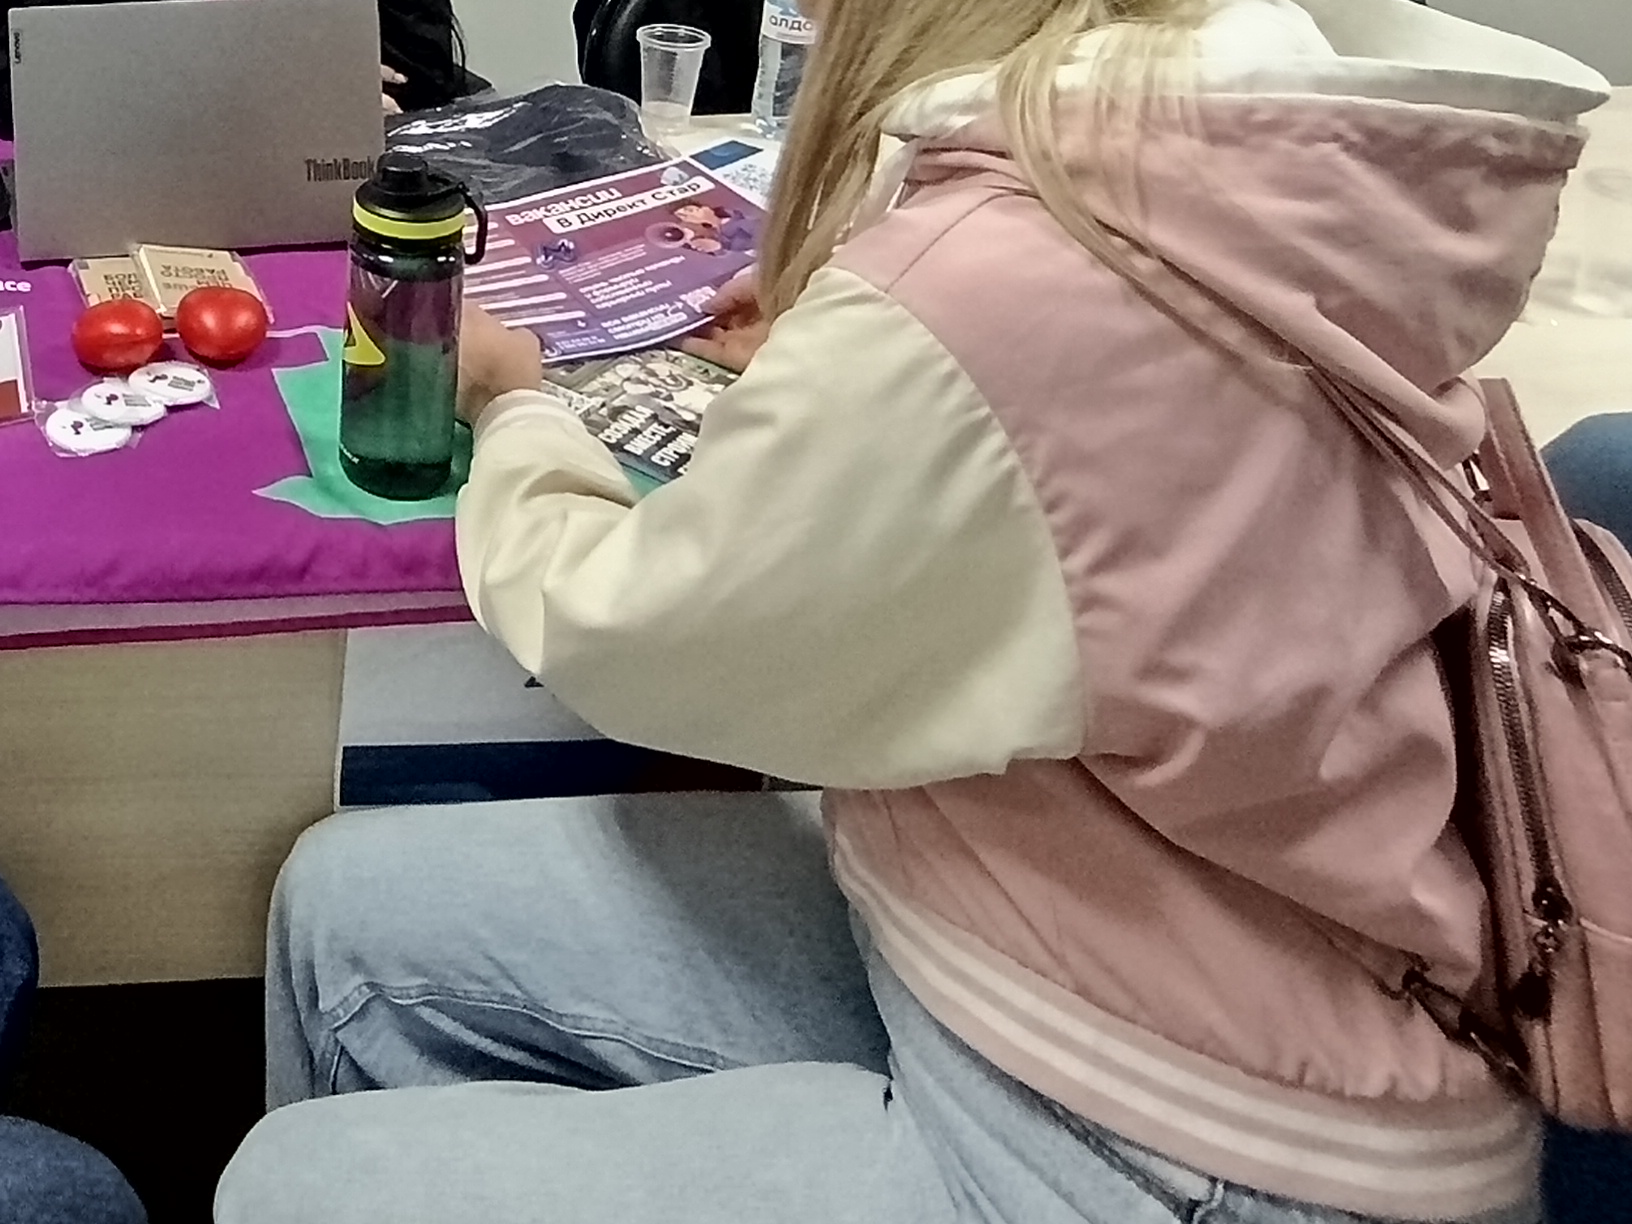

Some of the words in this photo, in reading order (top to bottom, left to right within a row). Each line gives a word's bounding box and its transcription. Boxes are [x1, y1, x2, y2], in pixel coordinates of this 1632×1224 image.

[304, 156, 376, 182] ThinkBook
[505, 187, 622, 226] вакансии
[579, 198, 648, 225] Директ
[651, 181, 701, 201] Стар
